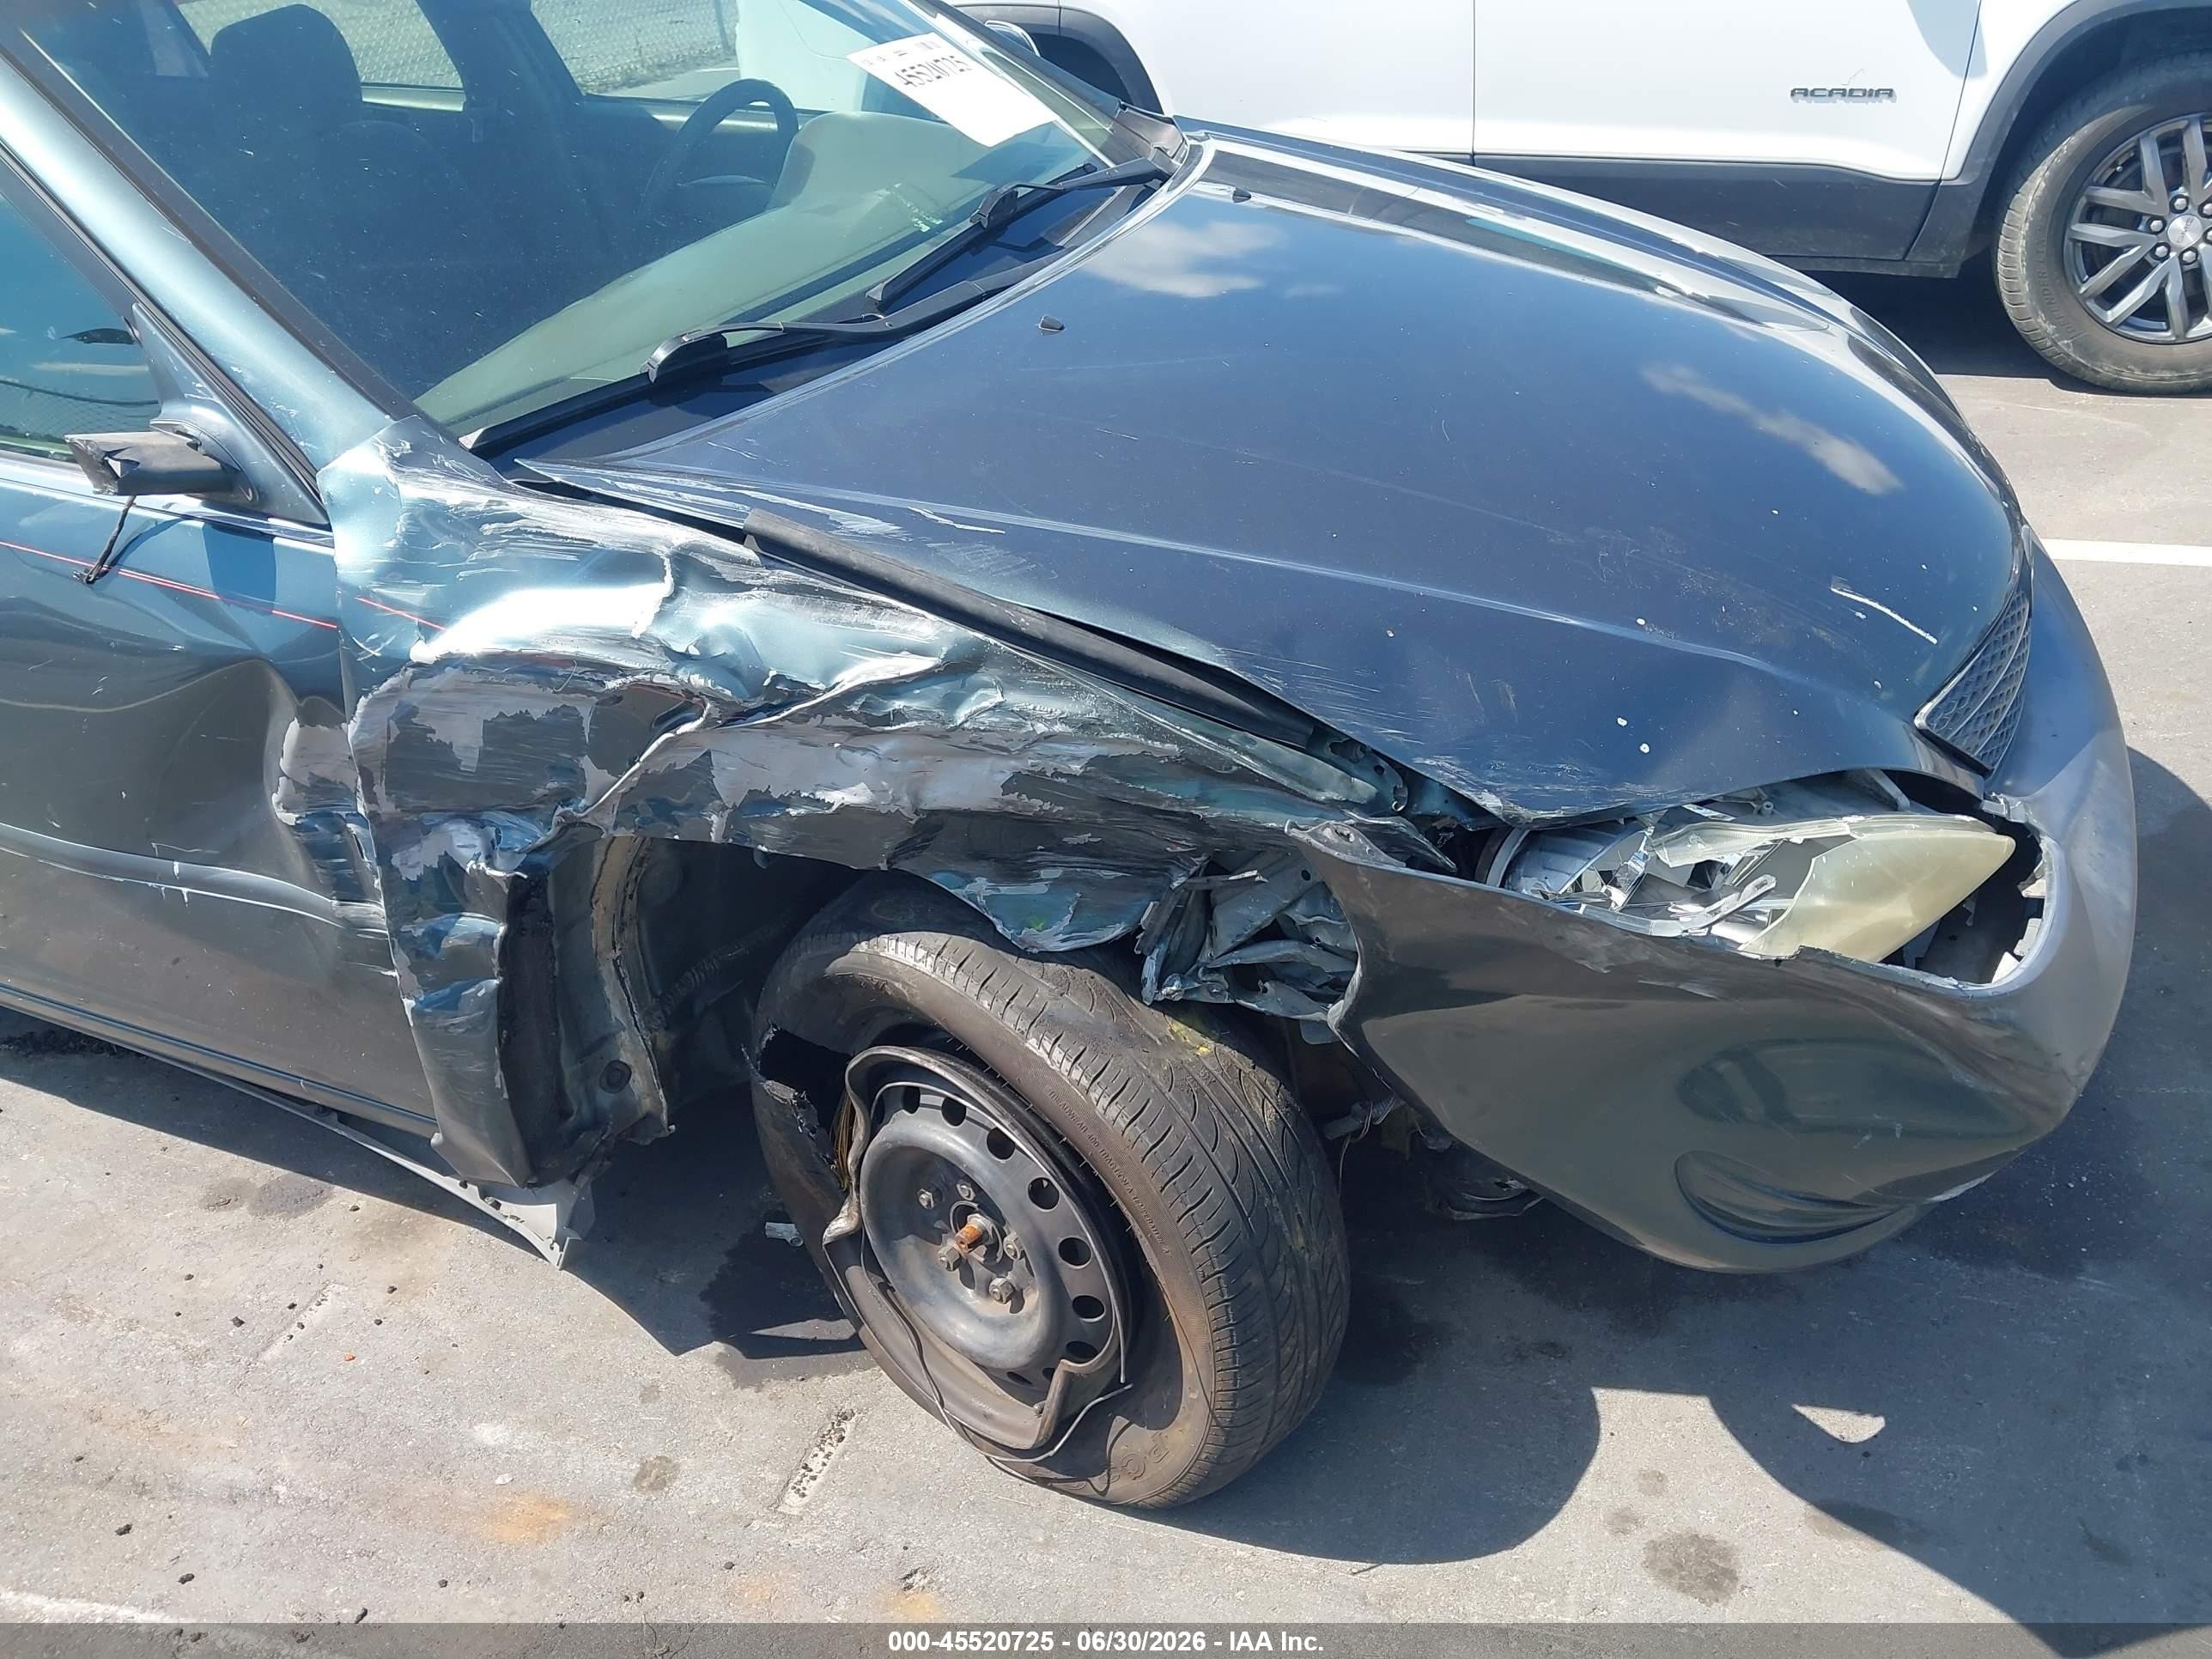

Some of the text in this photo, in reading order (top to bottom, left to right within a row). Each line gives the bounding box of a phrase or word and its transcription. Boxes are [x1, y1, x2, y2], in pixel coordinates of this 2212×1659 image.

[894, 55, 972, 88] 45520725
[1790, 88, 1894, 99] ACADIA
[2176, 217, 2194, 243] GMC
